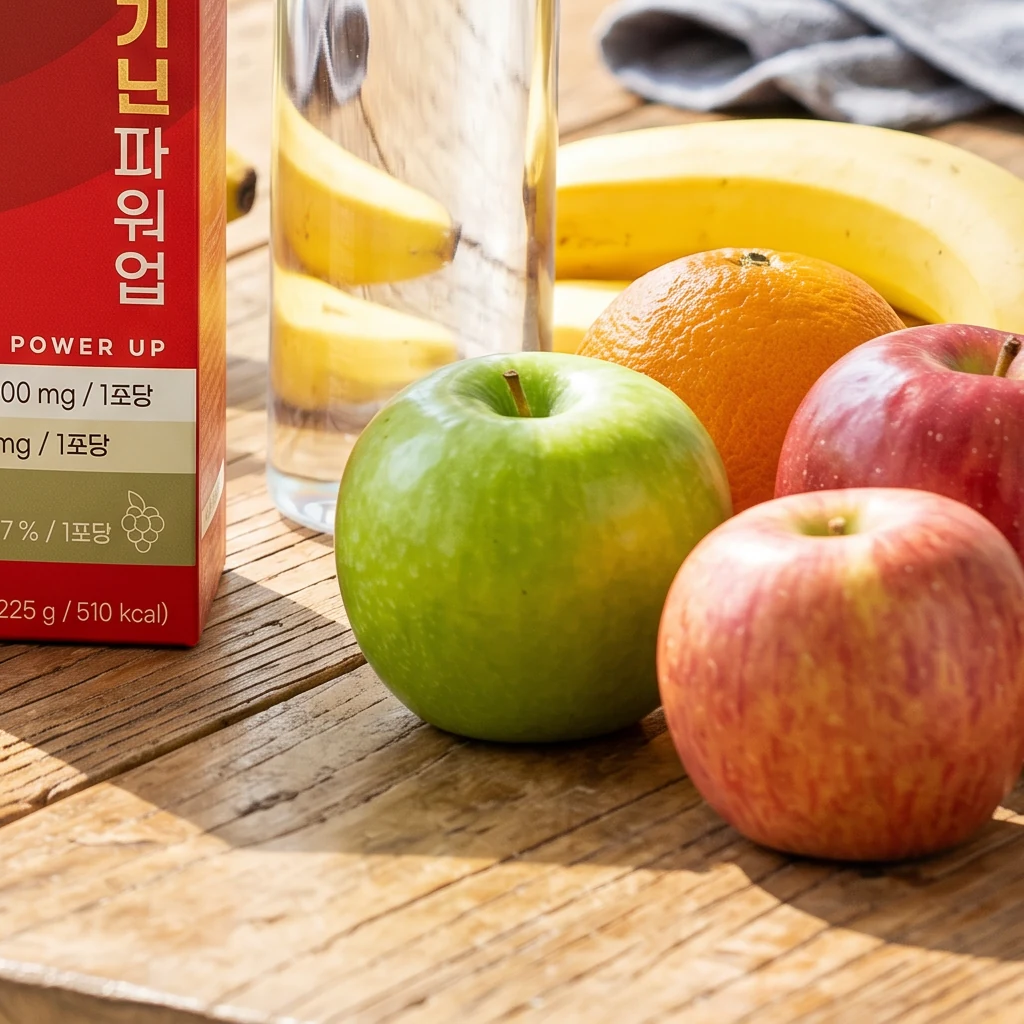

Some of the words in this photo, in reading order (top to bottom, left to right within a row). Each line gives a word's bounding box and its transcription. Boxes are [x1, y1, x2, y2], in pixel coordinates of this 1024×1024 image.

[11, 335, 113, 356] POWER
[129, 338, 165, 357] UP
[38, 387, 75, 411] mg
[82, 381, 94, 407] /
[38, 431, 50, 456] /
[0, 519, 14, 540] 7
[18, 520, 39, 542] %
[45, 519, 56, 543] /
[61, 521, 112, 545] 1포당
[42, 605, 55, 626] g
[62, 600, 72, 623] /
[77, 601, 113, 622] 510
[120, 601, 168, 626] kcal)
